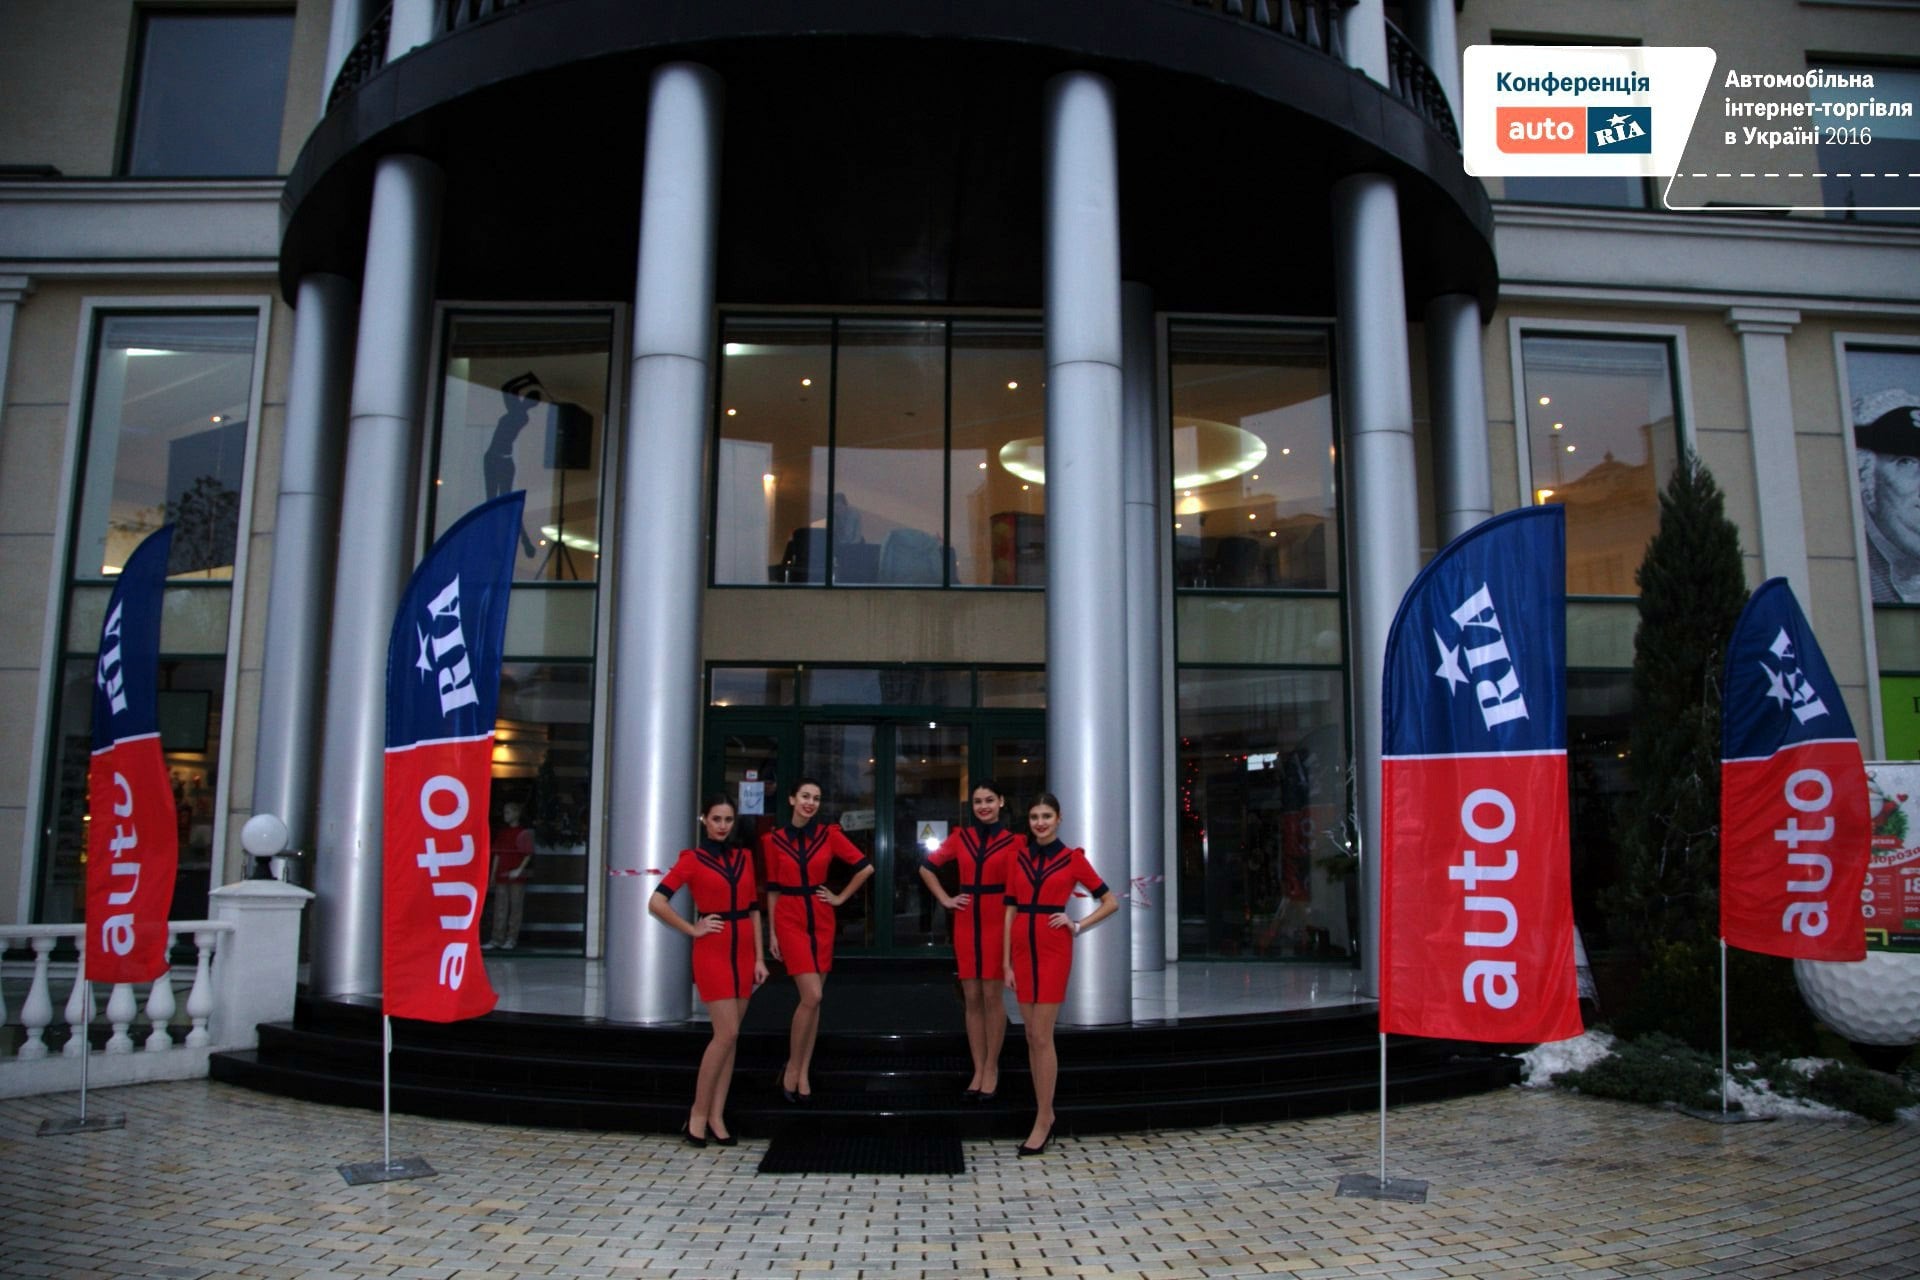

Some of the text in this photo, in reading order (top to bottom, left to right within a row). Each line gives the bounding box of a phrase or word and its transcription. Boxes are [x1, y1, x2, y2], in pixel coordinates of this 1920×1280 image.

[416, 574, 479, 991] auto RIA
[1448, 581, 1530, 1010] auto RIA
[1774, 768, 1834, 937] auto
